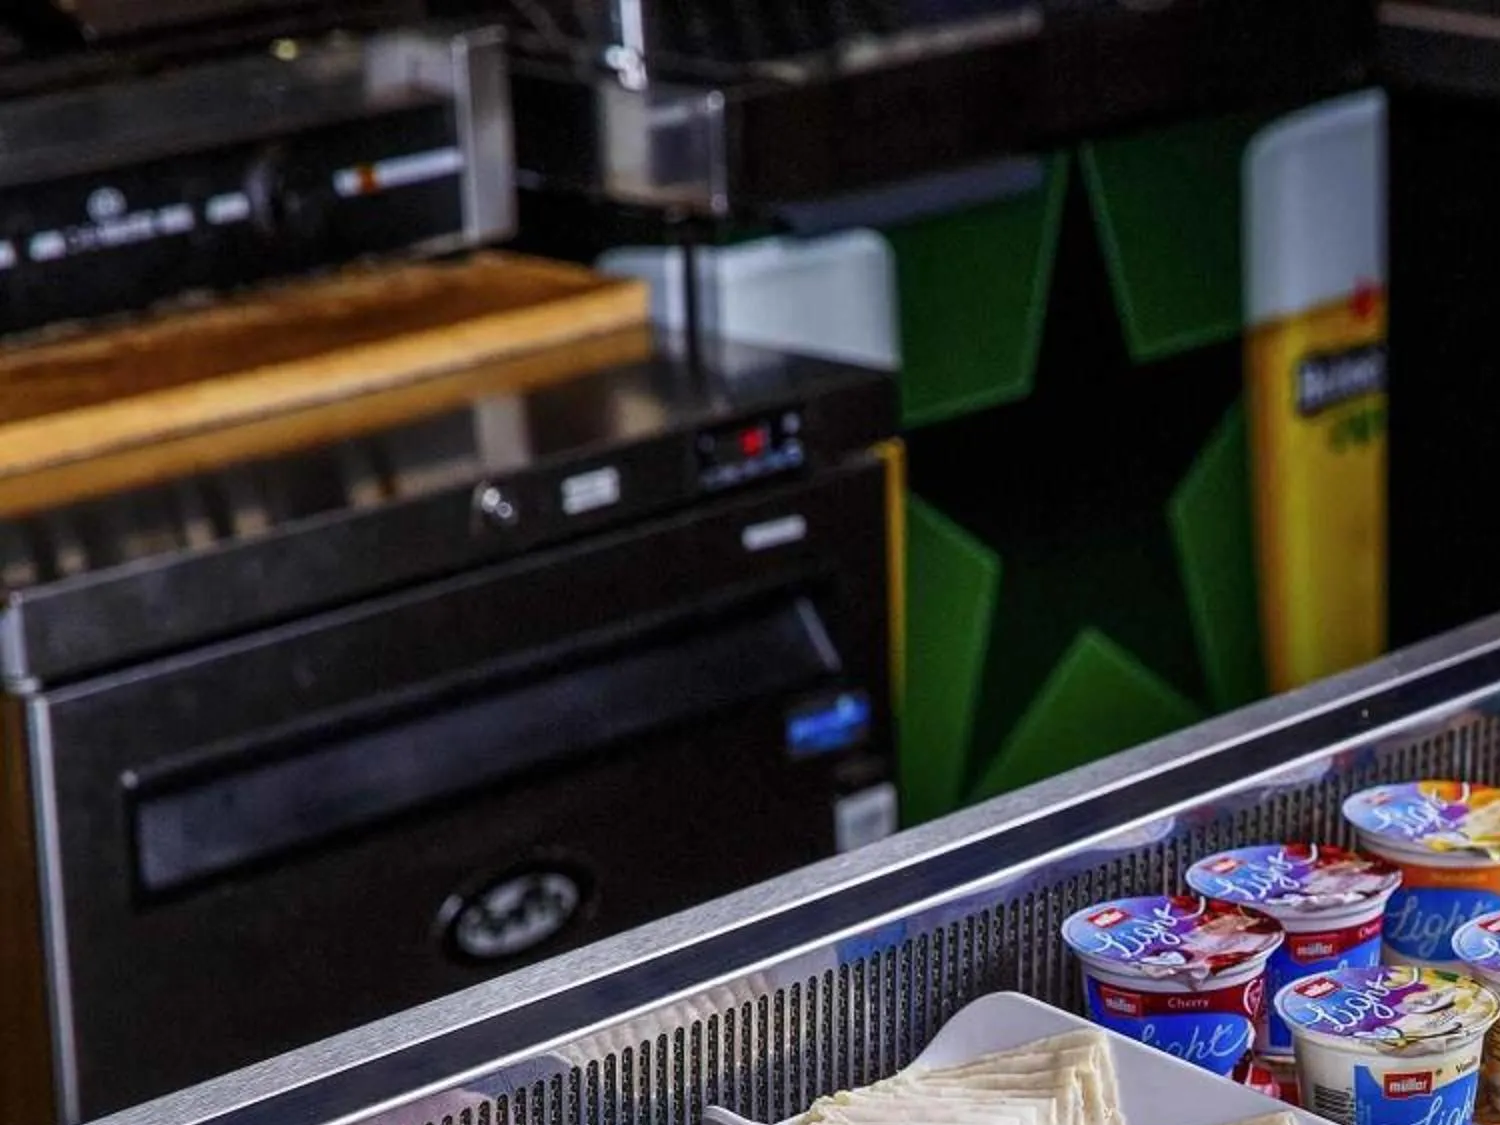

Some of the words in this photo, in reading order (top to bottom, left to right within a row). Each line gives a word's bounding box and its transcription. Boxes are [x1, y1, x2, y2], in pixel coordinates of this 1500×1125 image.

[1089, 896, 1206, 958] Light
[1167, 997, 1210, 1009] Cherry
[1300, 966, 1420, 1032] Light
